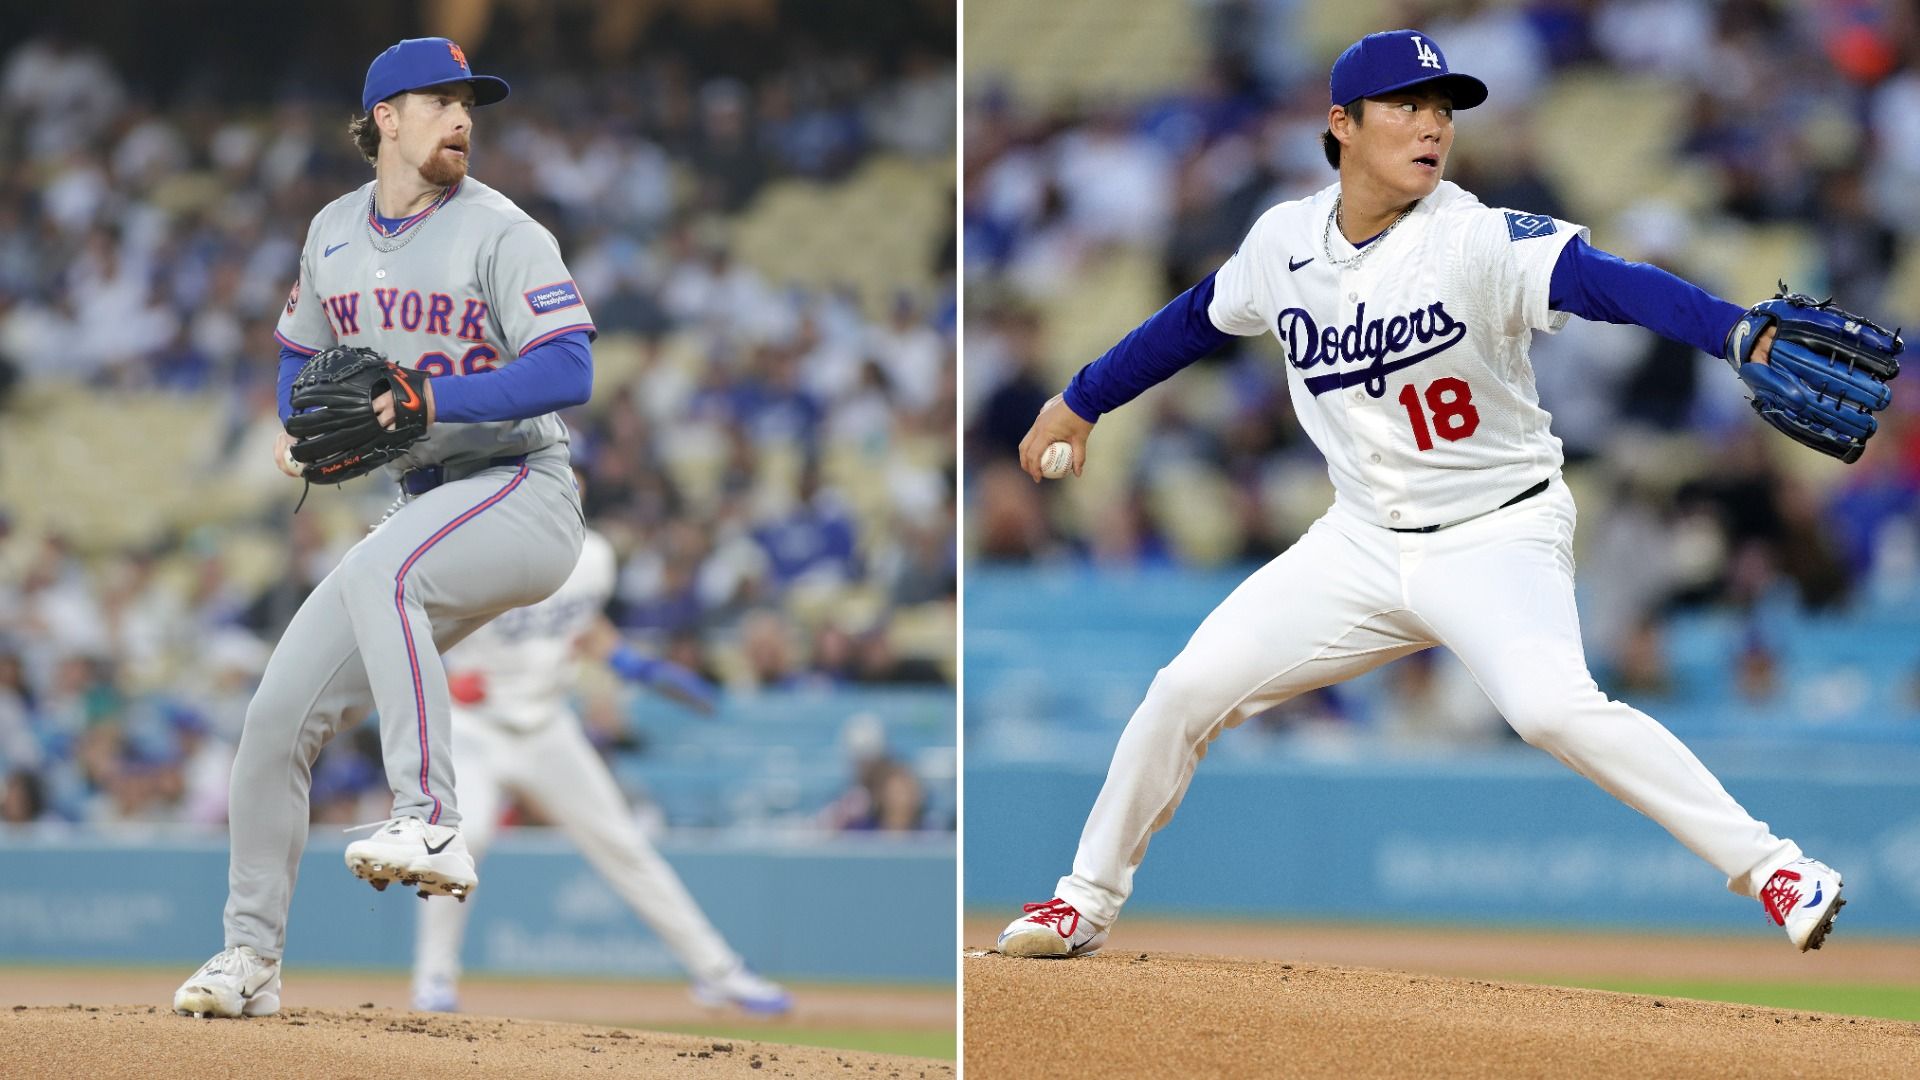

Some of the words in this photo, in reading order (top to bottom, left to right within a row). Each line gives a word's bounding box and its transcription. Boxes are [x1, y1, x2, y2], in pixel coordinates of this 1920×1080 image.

[1410, 36, 1442, 70] LA
[373, 288, 489, 342] YORK
[1278, 301, 1467, 398] Dodgers
[1398, 376, 1480, 451] 18
